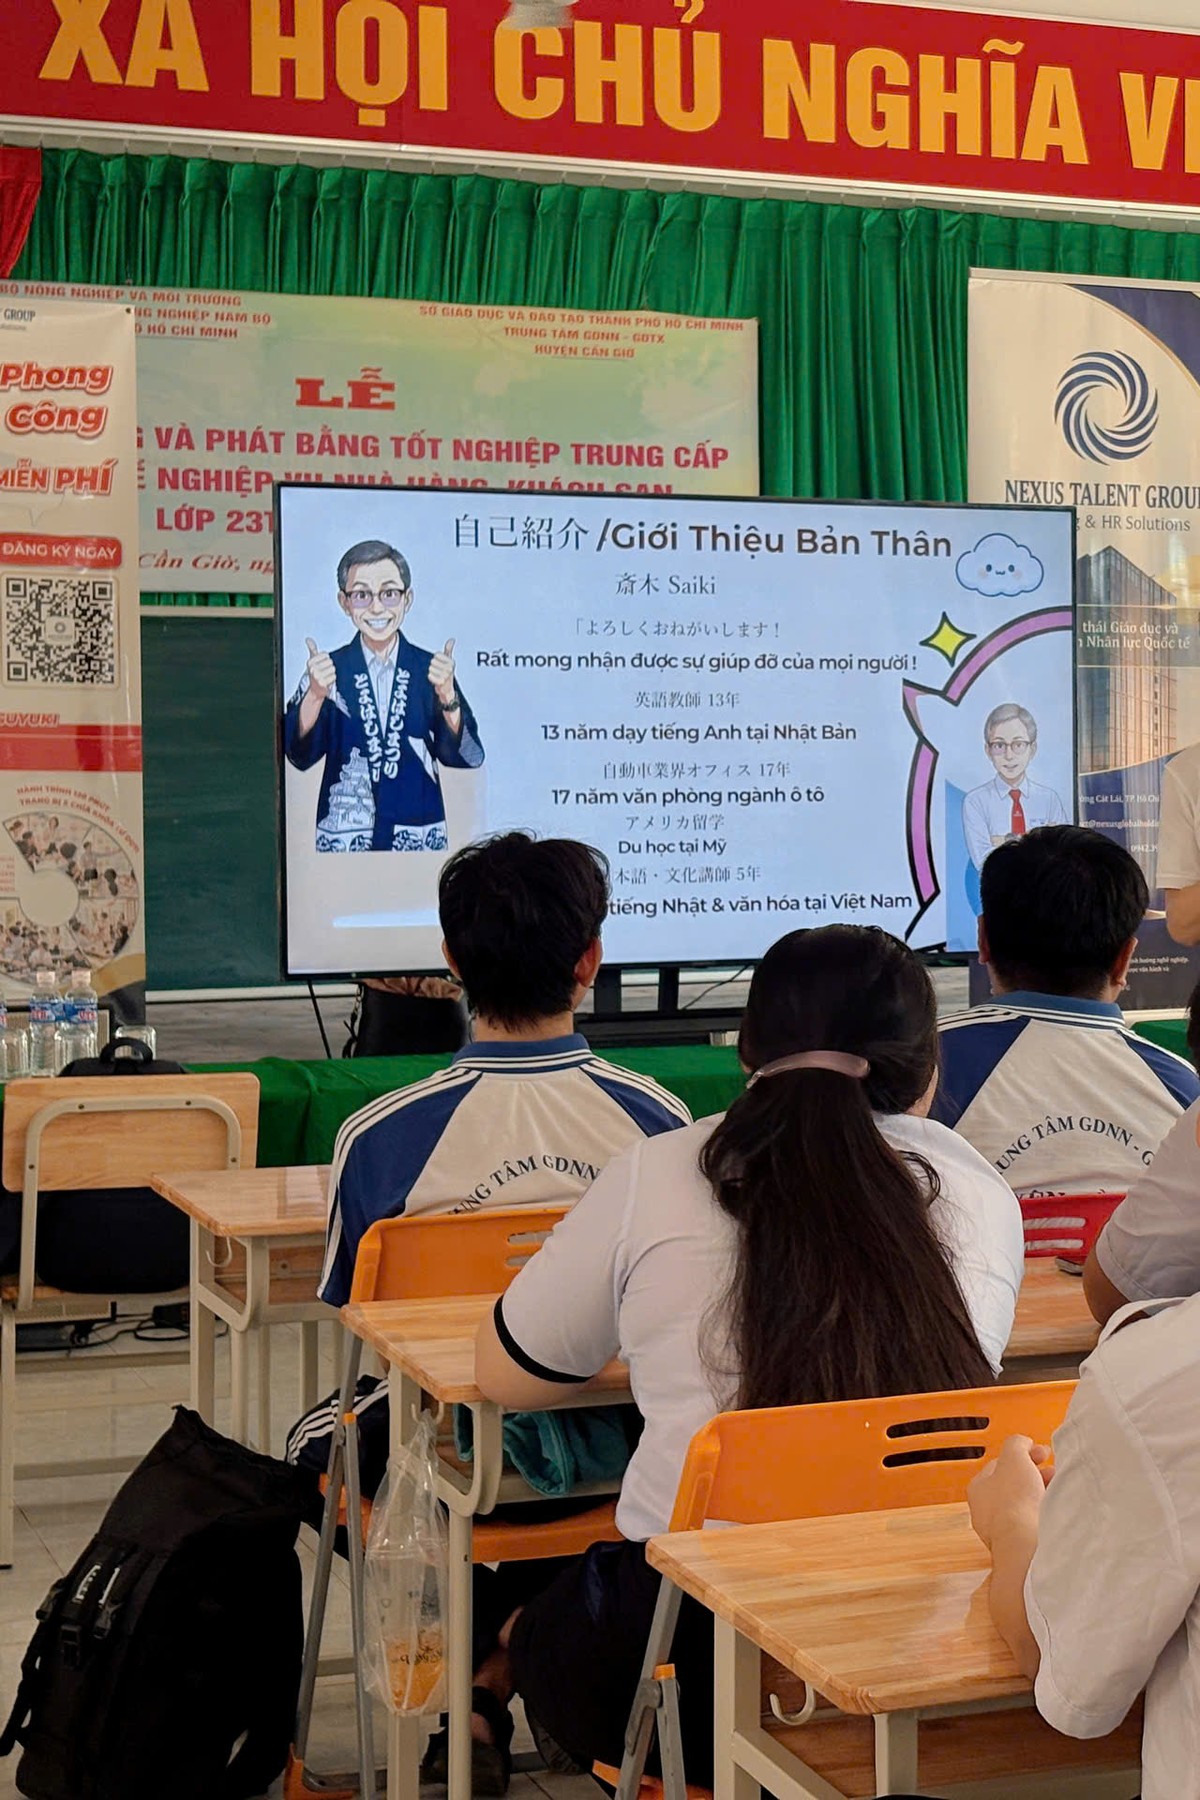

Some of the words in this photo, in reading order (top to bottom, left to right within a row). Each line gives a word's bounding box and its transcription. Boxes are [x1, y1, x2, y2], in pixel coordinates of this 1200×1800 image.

[494, 0, 722, 133] CHỦ
[763, 37, 1089, 166] NGHĨA
[4, 308, 36, 322] GROUP
[503, 326, 547, 338] TRUNG
[0, 361, 113, 396] Phong
[295, 367, 397, 410] LỄ
[6, 401, 108, 439] Công
[155, 422, 196, 451] VÀ
[206, 425, 286, 454] PHÁT
[296, 424, 381, 458] BẰNG
[390, 429, 443, 461] TỐT
[453, 436, 561, 469] NGHIỆP
[570, 443, 665, 467] TRUNG
[673, 439, 729, 469] CẤP
[54, 458, 119, 495] PHÍ
[158, 465, 274, 498] NGHIỆP
[1005, 480, 1064, 504] NEXUS
[1070, 482, 1141, 507] TALENT
[157, 505, 215, 532] LỚP
[1085, 515, 1096, 529] &
[1102, 515, 1122, 529] HR
[1126, 515, 1190, 531] Solutions
[454, 514, 589, 550] 自己紹介
[689, 524, 784, 560] Thiệu
[797, 524, 860, 556] Bản
[870, 529, 953, 557] Thân
[75, 546, 117, 560] NGAY
[668, 575, 717, 596] Saiki
[1083, 620, 1106, 633] thái
[1110, 621, 1137, 633] Giáo
[1140, 622, 1161, 635] dục
[1165, 622, 1178, 634] và
[1086, 635, 1120, 648] Nhân
[1123, 636, 1141, 650] lực
[1144, 635, 1176, 651] Quốc
[1178, 636, 1191, 649] tế
[476, 648, 510, 668] Rất
[514, 654, 573, 672] mong
[577, 651, 626, 672] nhận
[630, 651, 679, 673] được
[682, 654, 705, 673] sự
[709, 652, 751, 673] giúp
[754, 653, 777, 670] đỡ
[782, 653, 814, 670] của
[819, 655, 853, 674] mọi
[857, 654, 910, 674] người
[635, 690, 702, 709] 英語教師
[708, 691, 741, 709] 13年
[541, 724, 560, 741] 13
[564, 723, 608, 742] năm
[612, 724, 648, 744] dạy
[651, 721, 700, 744] tiếng
[704, 724, 742, 741] Anh
[746, 724, 770, 743] tại
[774, 723, 818, 742] Nhật
[822, 721, 857, 741] Bản
[759, 762, 791, 778] 17年
[552, 788, 570, 805] 17
[574, 787, 619, 805] năm
[622, 787, 657, 804] văn
[662, 786, 723, 807] phòng
[727, 787, 786, 808] ngành
[790, 785, 802, 802] ô
[806, 785, 825, 803] tô
[625, 813, 725, 831] アメリカ留学
[618, 840, 642, 855] Du
[645, 839, 676, 858] học
[678, 839, 700, 857] tại
[703, 837, 728, 856] Mỹ
[736, 866, 762, 882] 5年
[609, 896, 658, 918] tiếng
[663, 896, 707, 917] Nhật
[712, 898, 725, 913] &
[728, 895, 762, 912] văn
[766, 894, 800, 912] hóa
[804, 895, 827, 913] tại
[831, 893, 866, 912] Việt
[870, 894, 912, 909] Nam
[995, 1134, 1031, 1175] UNG
[1032, 1115, 1075, 1141] TÂM
[1079, 1116, 1133, 1147] GDNN
[460, 1183, 492, 1212] UNG
[489, 1154, 538, 1188] TÂM
[542, 1154, 602, 1182] GDNN
